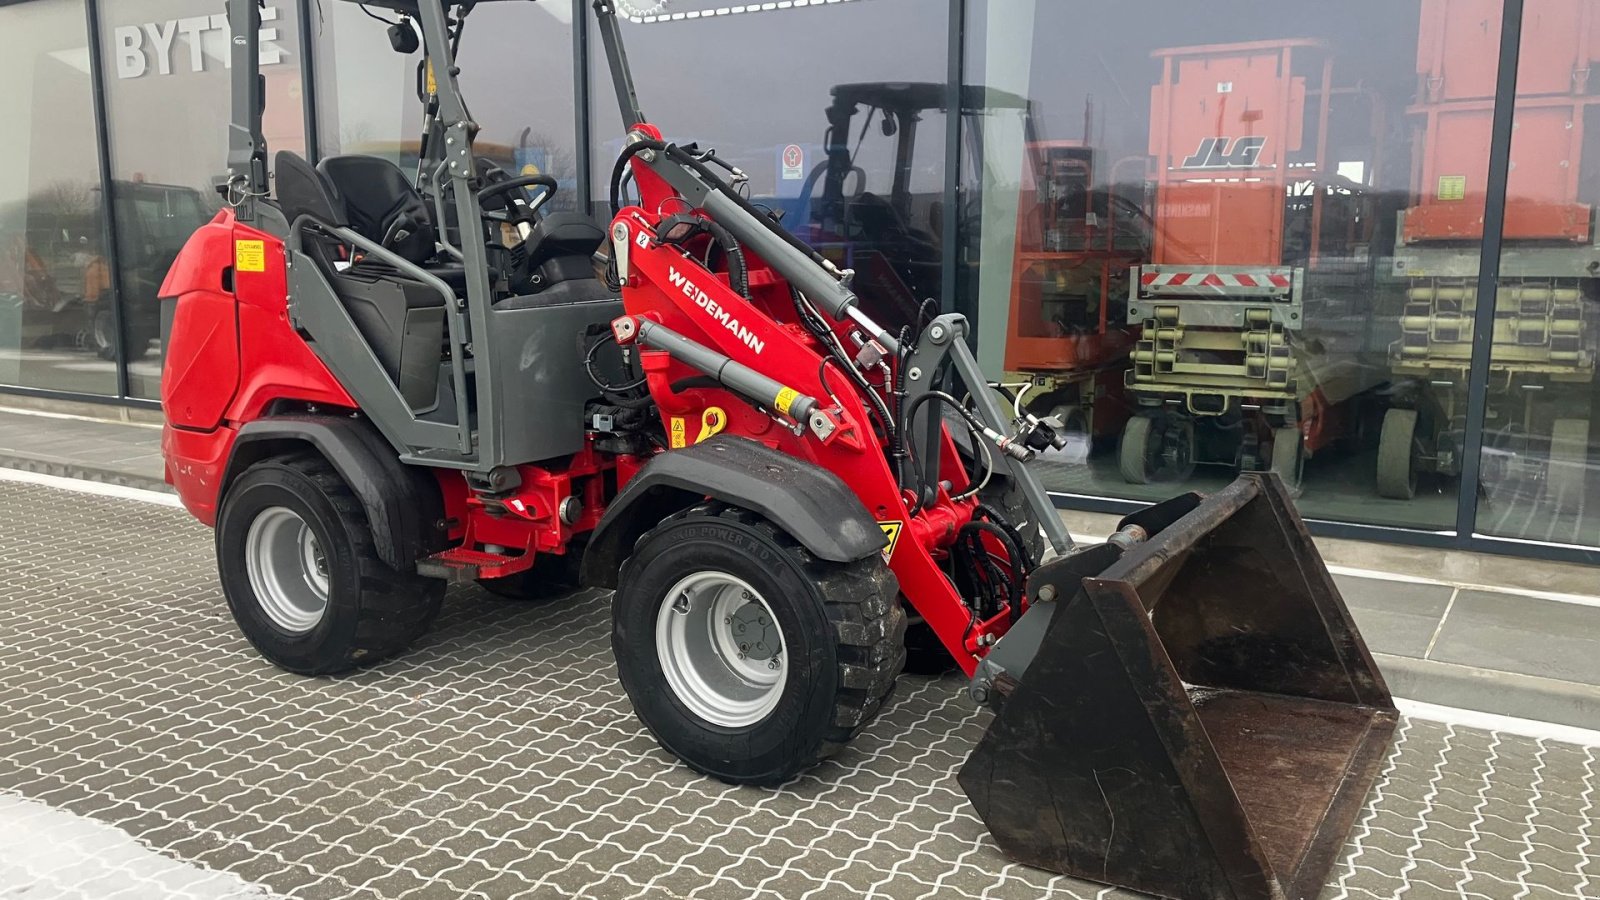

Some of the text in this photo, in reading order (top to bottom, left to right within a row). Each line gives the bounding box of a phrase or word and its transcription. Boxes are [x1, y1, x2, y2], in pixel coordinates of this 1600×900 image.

[1181, 136, 1267, 168] JLG
[668, 266, 765, 355] WEIDEMANN
[701, 527, 745, 545] POWER
